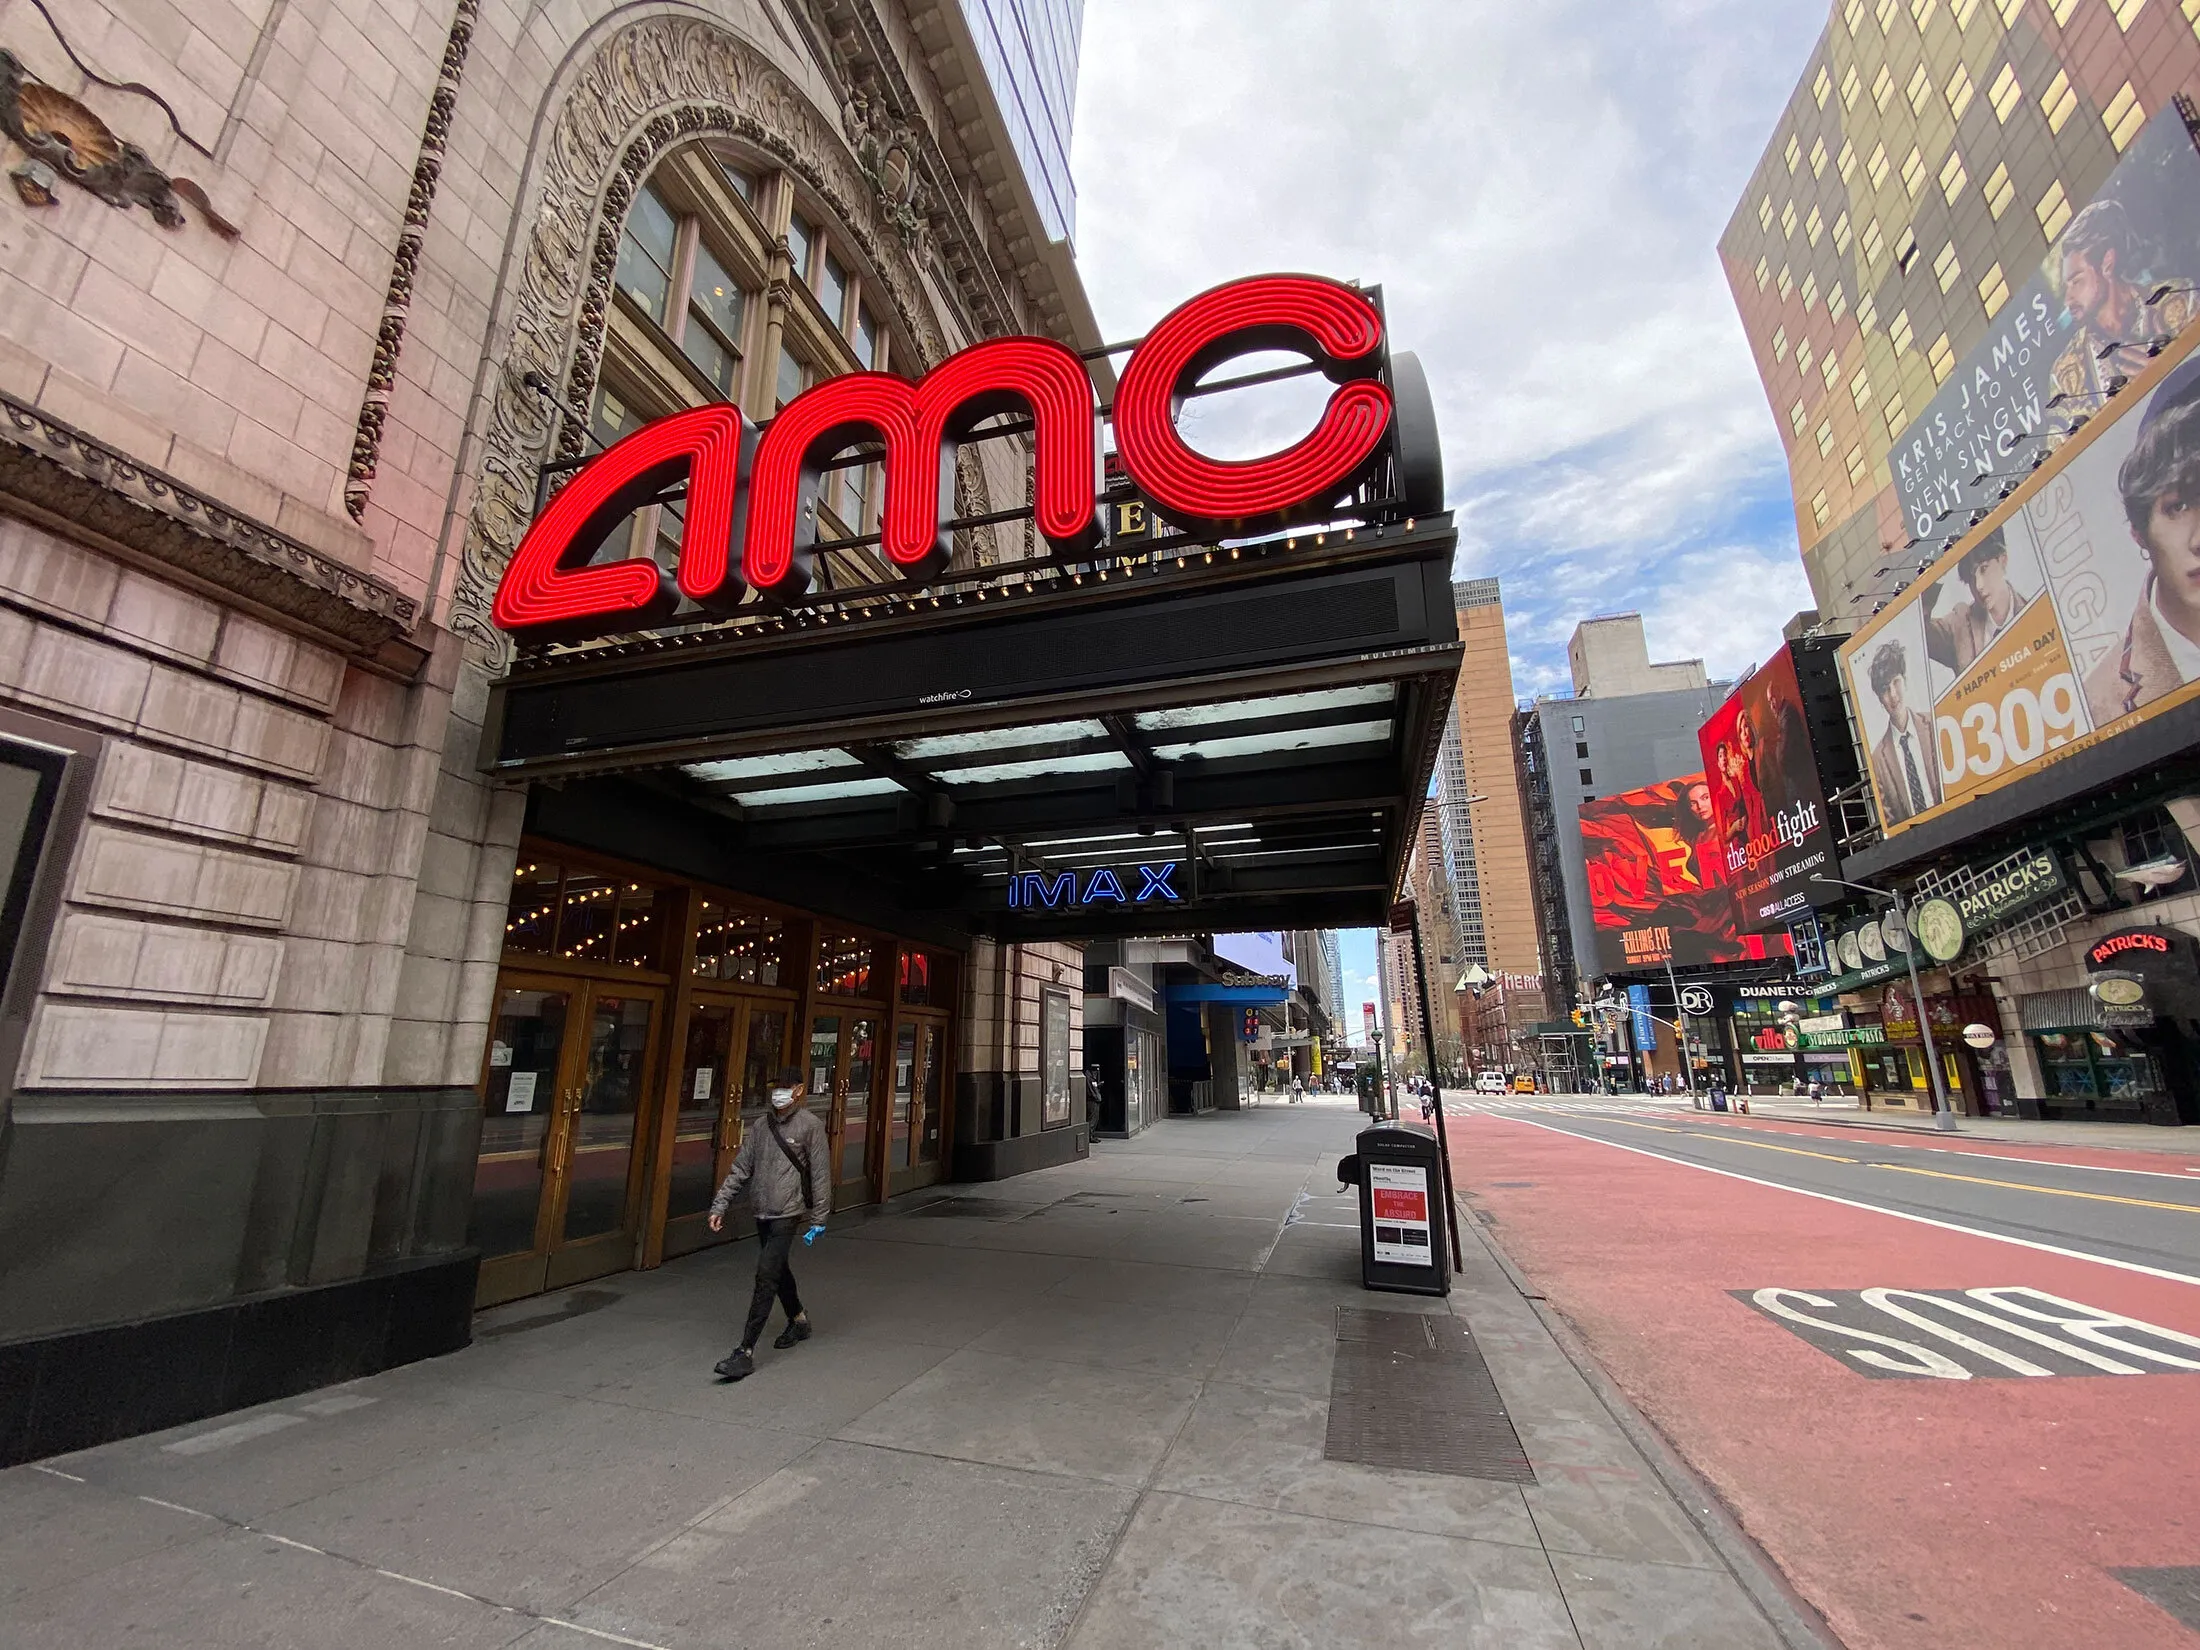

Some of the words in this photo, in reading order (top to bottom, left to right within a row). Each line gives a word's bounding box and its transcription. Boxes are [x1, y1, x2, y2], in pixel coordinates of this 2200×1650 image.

[1898, 412, 1947, 479] KRIS
[1961, 293, 2047, 409] JAMES
[1904, 461, 1930, 493] GET
[1934, 410, 1975, 461] BACK
[1980, 381, 2000, 409] TO
[2008, 318, 2056, 378] LOVE
[493, 273, 1394, 630] amc
[1910, 468, 1949, 519] NEW
[1958, 377, 2037, 469] SINGLE
[1916, 478, 1962, 538] OUT
[1974, 396, 2042, 475] NOW
[1963, 667, 1997, 696] HAPPY
[1999, 646, 2032, 673] SUGA
[2033, 628, 2056, 652] DAY
[919, 691, 958, 704] watchfire
[1936, 672, 2088, 785] 0309
[2071, 735, 2100, 756] FROM
[2106, 714, 2145, 738] CHINA
[1008, 863, 1179, 908] IMAX
[1735, 887, 1748, 900] NEW
[1747, 878, 1770, 895] SEASON
[1769, 868, 1785, 886] NOW
[1784, 851, 1825, 879] STREAMING
[1959, 855, 2053, 919] PATRICK'S
[1760, 905, 1771, 917] CBS
[1774, 899, 1785, 912] ALL
[1783, 891, 1805, 909] ACCESS
[1622, 926, 1655, 954] KILLING
[1654, 926, 1672, 951] EVE
[2092, 933, 2168, 964] PATRICK'S
[1222, 971, 1291, 989] Subway
[1739, 986, 1787, 997] DUANE
[1754, 1027, 1786, 1050] villa
[1380, 1190, 1419, 1201] EMBRACE
[1383, 1208, 1418, 1220] ABSURD
